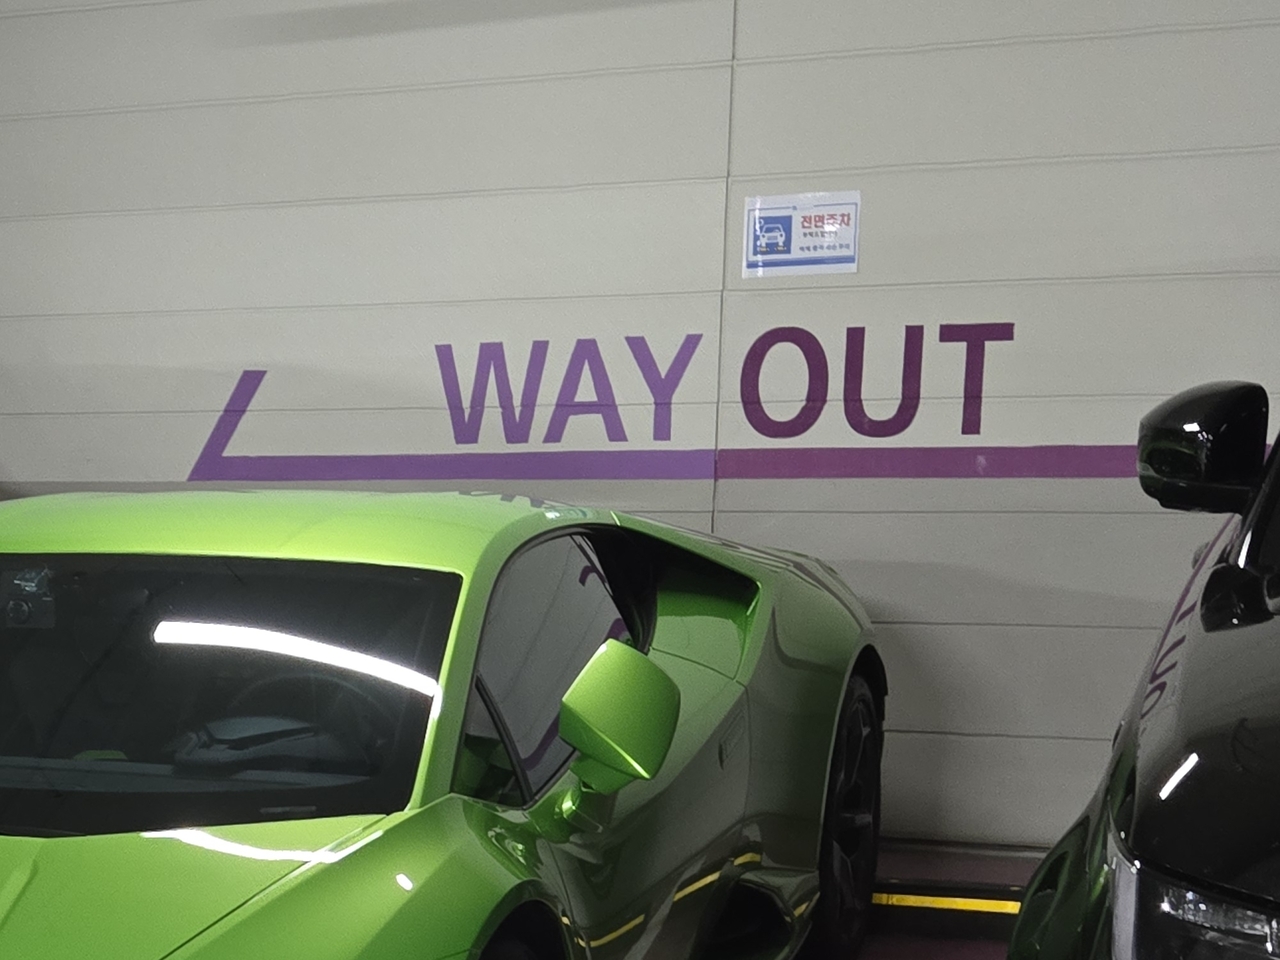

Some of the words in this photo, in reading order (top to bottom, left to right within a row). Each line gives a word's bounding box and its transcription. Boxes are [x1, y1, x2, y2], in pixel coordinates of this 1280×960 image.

[800, 211, 852, 230] 전면주차
[434, 333, 703, 445] WAY
[740, 322, 1015, 439] OUT
